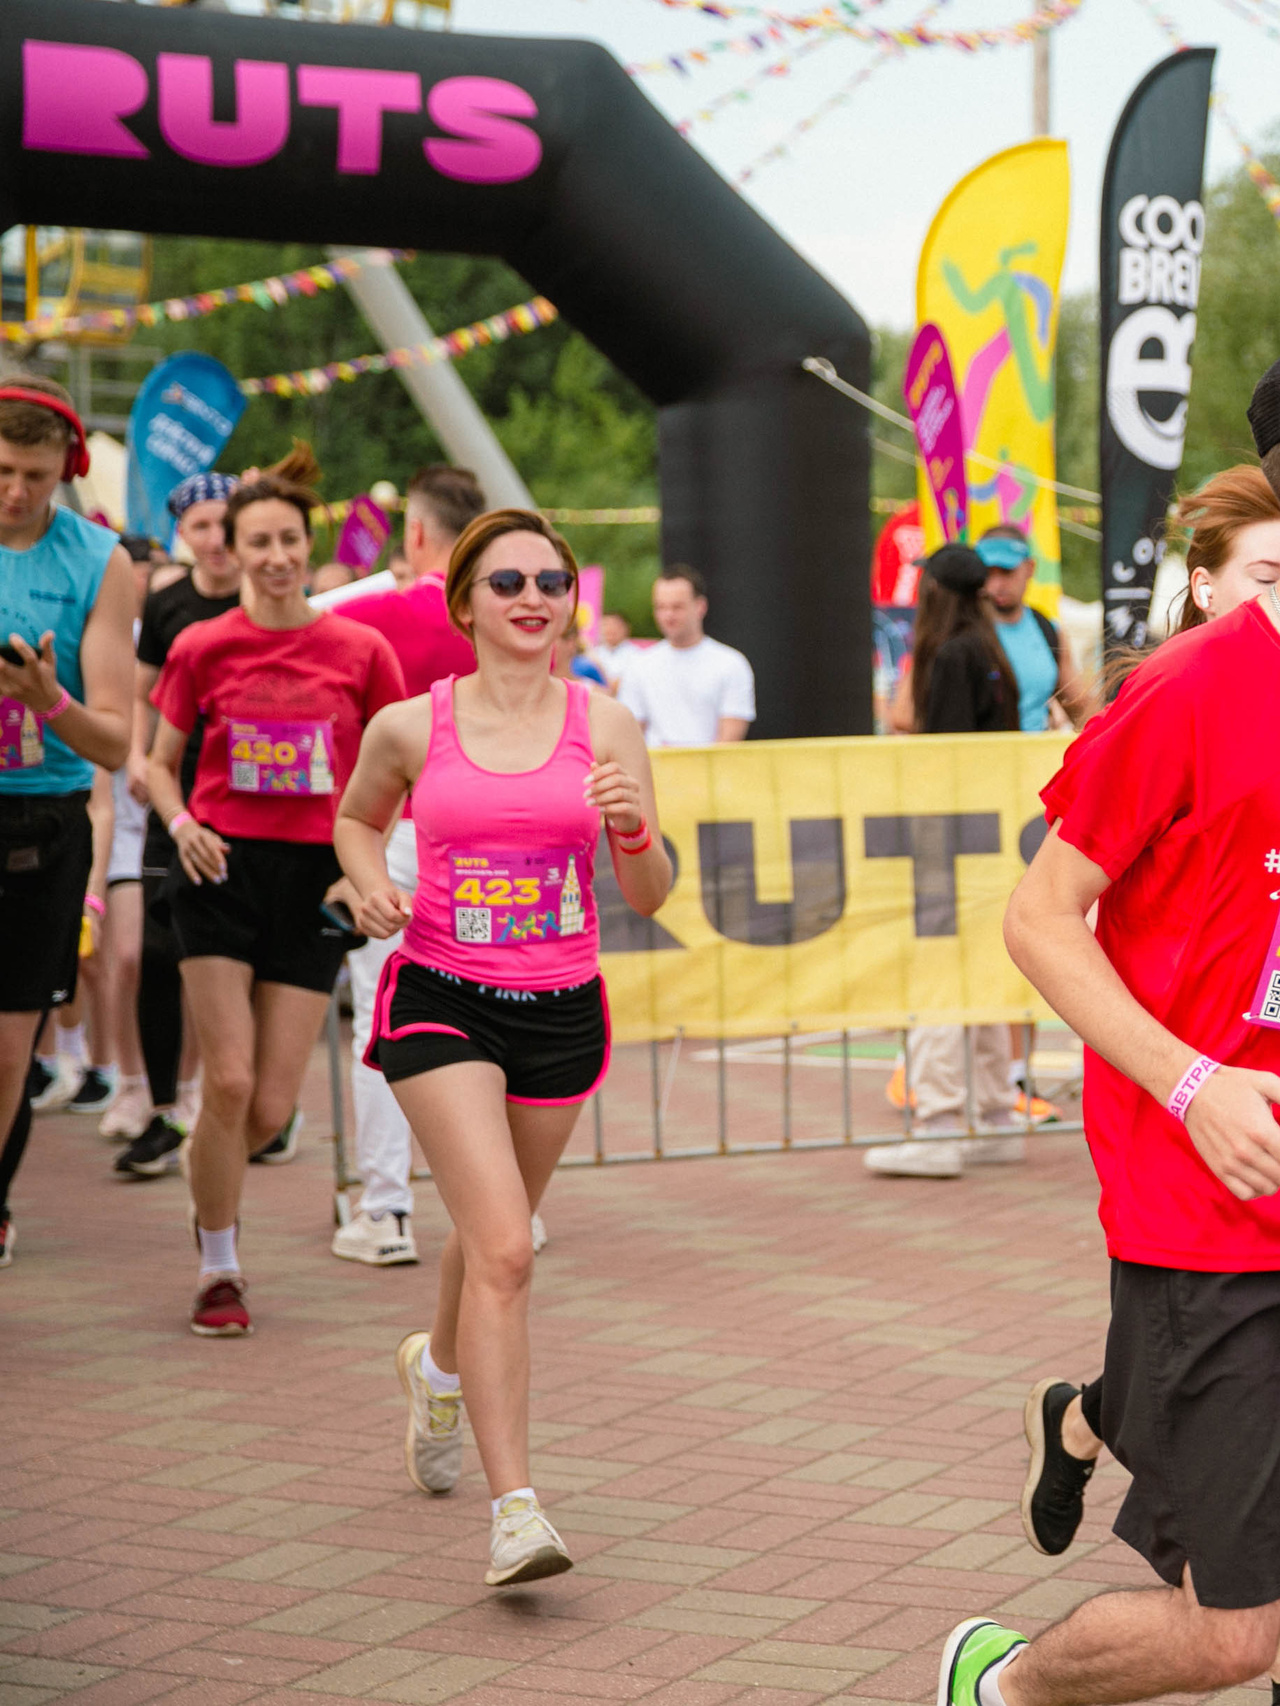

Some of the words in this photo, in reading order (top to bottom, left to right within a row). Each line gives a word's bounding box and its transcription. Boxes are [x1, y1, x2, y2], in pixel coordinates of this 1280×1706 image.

[22, 38, 543, 186] RUTS
[231, 740, 297, 766] 420
[454, 877, 541, 906] 423
